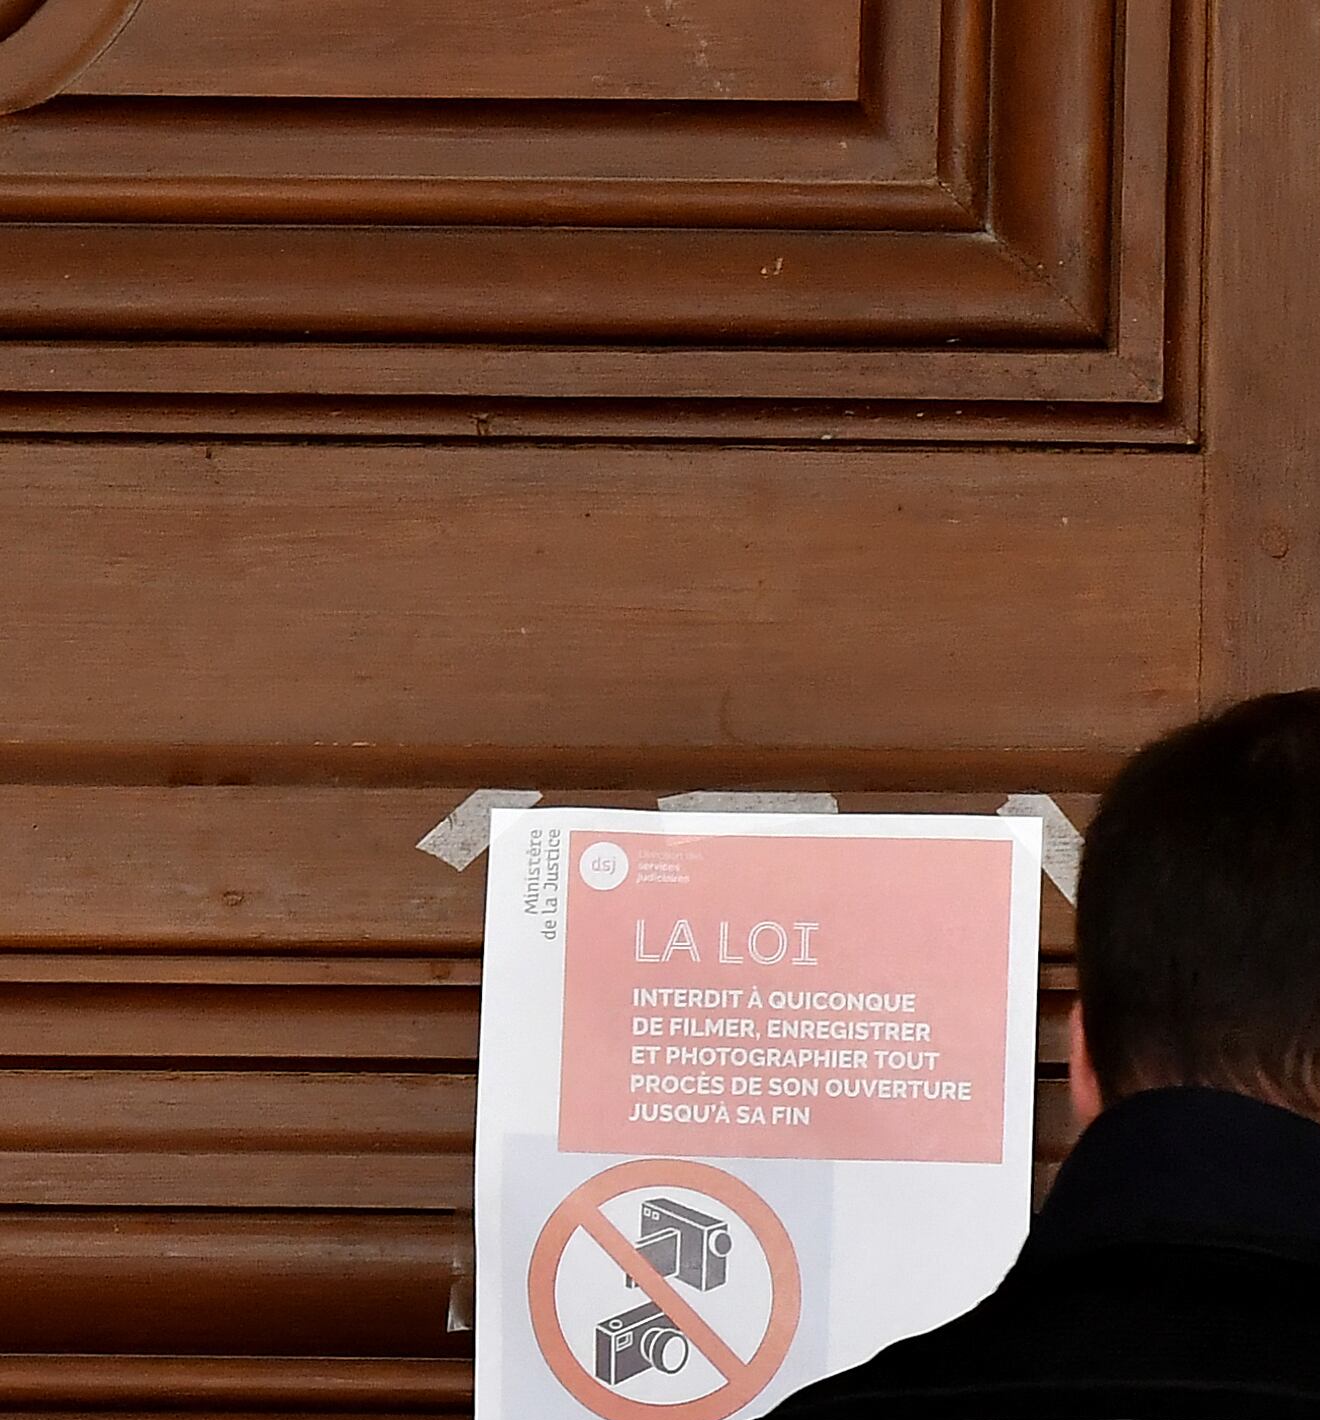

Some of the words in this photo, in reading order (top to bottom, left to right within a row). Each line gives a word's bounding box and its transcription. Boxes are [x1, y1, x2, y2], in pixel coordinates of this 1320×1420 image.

[523, 829, 543, 915] Ministère
[543, 829, 561, 892] Justice
[591, 856, 617, 876] dsj
[541, 897, 558, 914] la
[540, 919, 557, 940] de
[635, 919, 701, 963] LA
[718, 921, 819, 966] LOI
[633, 988, 743, 1009] INTERDIT
[748, 985, 763, 1009] À
[768, 990, 916, 1012] QUICONQUE
[632, 1017, 663, 1036] DE
[669, 1018, 761, 1041] FILMER,
[767, 1020, 931, 1042] ENREGISTRER
[631, 1046, 661, 1065] ET
[666, 1047, 868, 1069] PHOTOGRAPHIER
[874, 1051, 940, 1071] TOUT
[630, 1071, 725, 1095] PROCÈS
[731, 1077, 762, 1095] DE
[767, 1077, 819, 1097] SON
[825, 1078, 972, 1101] OUVERTURE
[628, 1101, 730, 1124] JUSQU'À
[736, 1106, 766, 1125] SA
[772, 1106, 810, 1126] FIN
